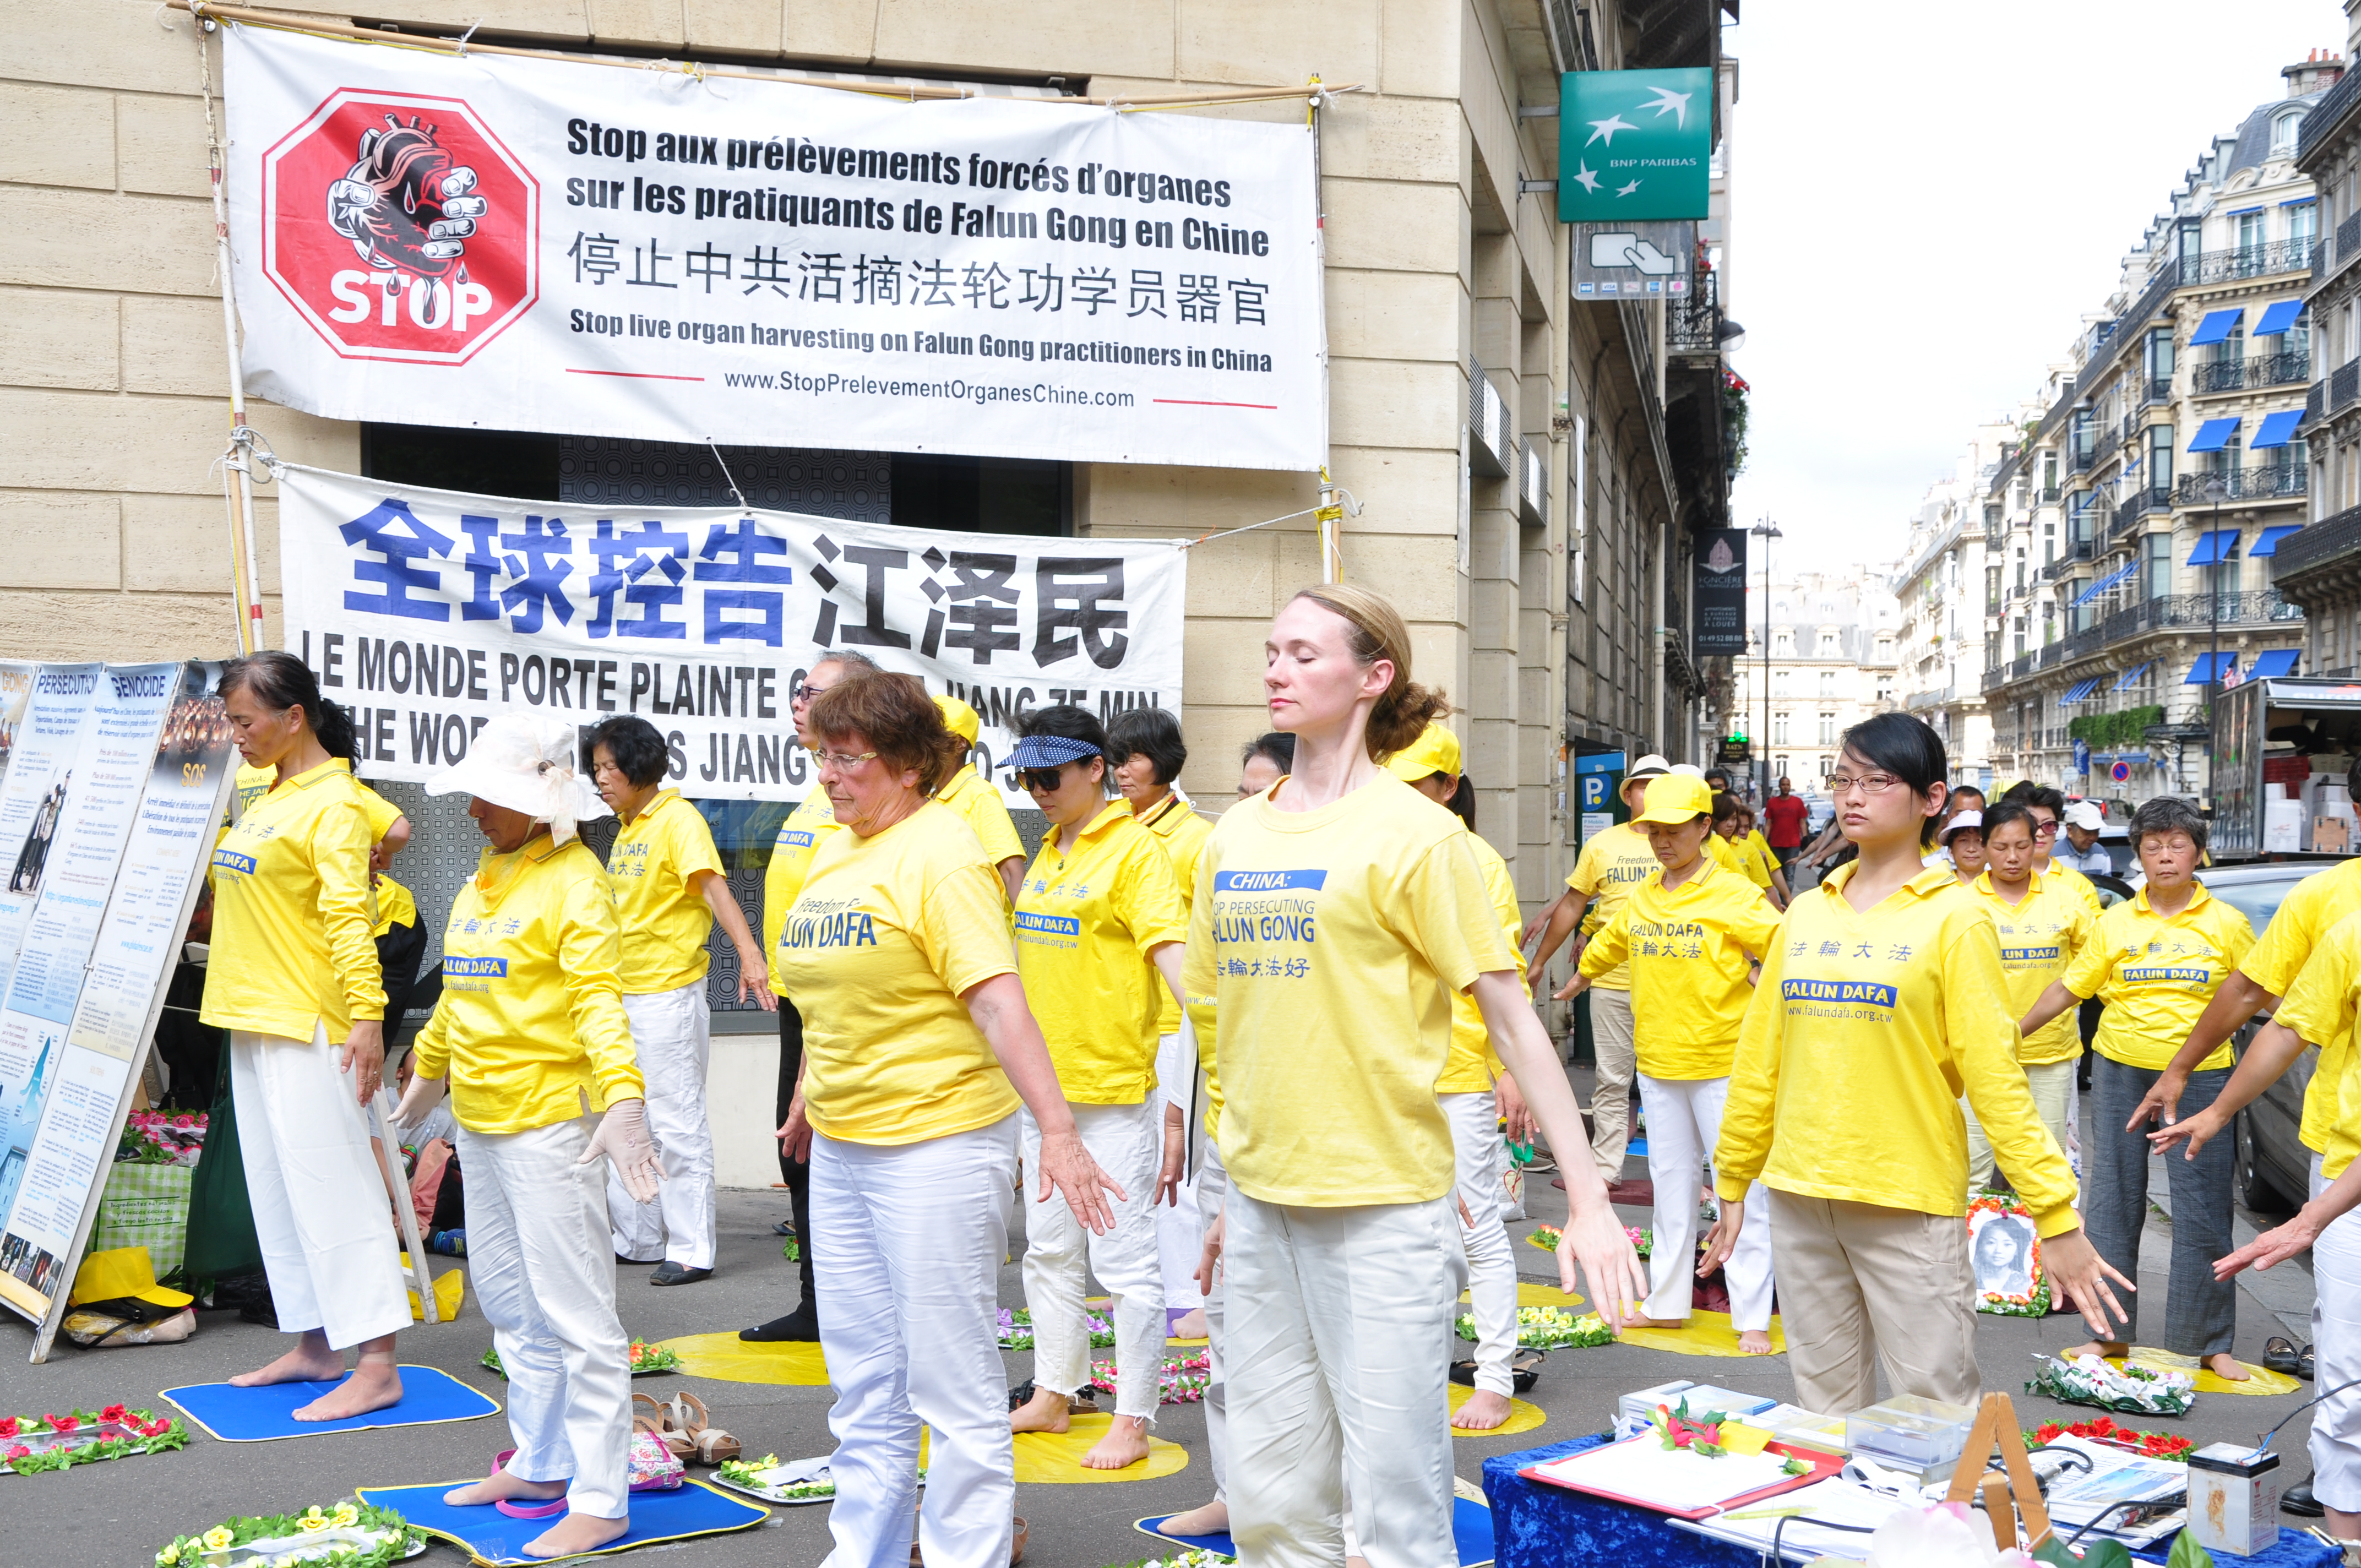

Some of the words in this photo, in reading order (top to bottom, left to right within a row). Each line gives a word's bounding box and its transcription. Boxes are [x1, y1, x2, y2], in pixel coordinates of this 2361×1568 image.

[568, 118, 646, 163] Stop
[656, 132, 718, 165] aux
[727, 135, 960, 186] prélèvements
[969, 153, 1069, 193] forcés
[1078, 162, 1231, 208] d'organes
[1609, 159, 1638, 168] BNP
[1640, 157, 1697, 167] PARIBAS
[567, 176, 624, 209] sur
[633, 176, 686, 215] les
[695, 186, 894, 231] pratiquants
[903, 198, 942, 235] de
[951, 201, 1037, 239] Falun
[1046, 207, 1126, 248] Gong
[1135, 219, 1173, 249] en
[1182, 217, 1269, 257] Chine
[567, 231, 1269, 326] 停止中共活摘法轮功学员器官
[329, 268, 493, 333] STOP
[570, 308, 623, 337] Stop
[629, 313, 671, 339] live
[678, 321, 745, 345] organ
[752, 323, 874, 353] harvesting
[880, 331, 908, 352] on
[914, 330, 973, 356] Falun
[979, 334, 1035, 361] Gong
[1040, 340, 1182, 367] practitioners
[1187, 346, 1206, 368] in
[1211, 347, 1272, 373] China
[725, 371, 1135, 407] www.StopPrelevementOrganesChine.com
[339, 497, 1129, 669] 全球控告江泽民
[2, 671, 29, 694] GONG
[303, 630, 344, 688] LE
[358, 636, 488, 701] MONDE
[500, 652, 617, 711] PORTE
[630, 662, 776, 718] PLAINTE
[335, 705, 396, 763] HE
[700, 732, 807, 786] JIANG
[181, 762, 206, 788] SOS
[1585, 777, 1604, 805] P
[146, 797, 159, 806] Arrêt
[142, 809, 163, 821] Libération
[788, 832, 809, 845] DAFA
[623, 843, 649, 857] DAFA
[224, 853, 250, 872] DAFA
[1617, 855, 1655, 865] Freedom
[1229, 873, 1292, 889] CHINA:
[1607, 866, 1647, 885] FALUN
[795, 897, 846, 914] Freedom
[1230, 899, 1315, 915] PERSECUTING
[818, 911, 878, 948] DAFA
[1043, 917, 1075, 933] DAFA
[1260, 914, 1315, 943] GONG
[1629, 922, 1663, 937] FALUN
[1666, 923, 1704, 938] DAFA
[1999, 924, 2061, 934] 輪大法
[1788, 940, 1912, 962] 法輪大法
[2027, 949, 2057, 958] DAFA
[442, 959, 471, 973] ALUN
[471, 960, 502, 974] DAFA
[2125, 970, 2167, 980] FALUN
[2170, 970, 2206, 981] DAFA
[1783, 982, 1838, 999] FALUN
[1842, 984, 1889, 1004] DAFA
[111, 1201, 147, 1209] Ingredientes
